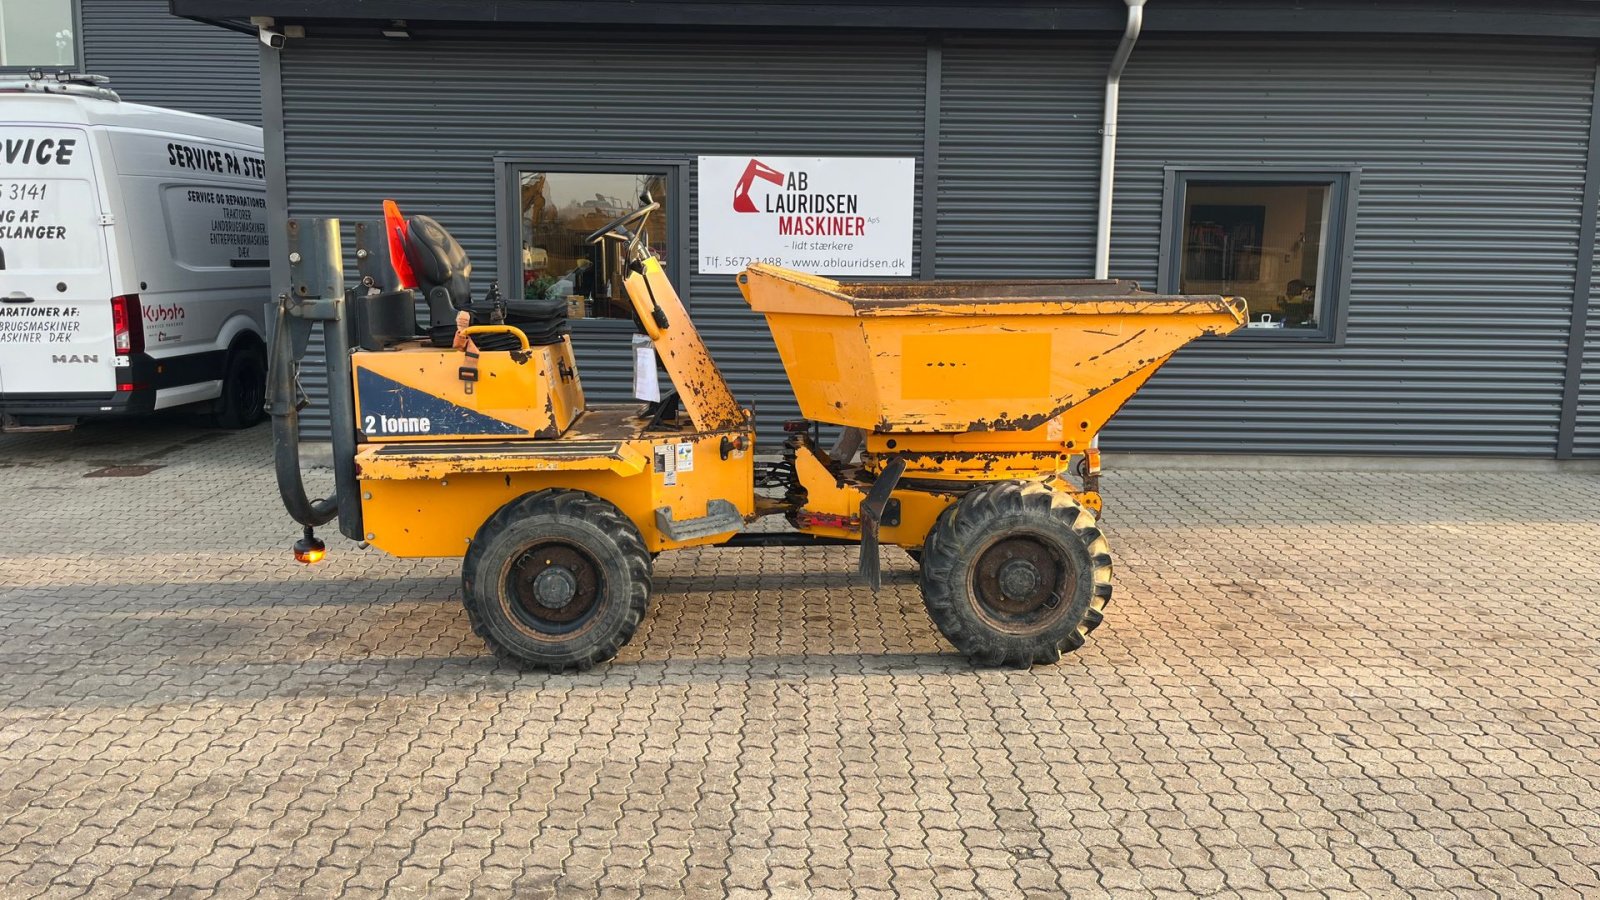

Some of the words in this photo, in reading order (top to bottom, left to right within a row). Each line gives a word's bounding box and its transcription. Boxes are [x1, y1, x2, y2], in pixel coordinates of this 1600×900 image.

[0, 138, 76, 165] VICE
[167, 142, 223, 173] SERVICE
[786, 171, 808, 191] AB
[9, 183, 47, 201] 3141
[187, 190, 215, 204] SERVICE
[215, 193, 225, 205] OG
[225, 194, 267, 209] REPARATIONER
[766, 193, 858, 214] LAURIDSEN
[20, 209, 40, 223] AF
[222, 207, 252, 221] TRAKTORER
[779, 216, 866, 236] MASKINER
[867, 216, 881, 224] ApS
[791, 240, 808, 251] lidt
[809, 240, 854, 251] stærkere
[704, 256, 722, 268] Tlf.
[725, 256, 752, 267] 5672
[792, 257, 906, 269] www.ablauridsen.dk
[62, 307, 80, 317] AF:
[142, 302, 185, 322] Kubota
[49, 332, 72, 343] DÆK
[52, 354, 98, 363] MAN
[365, 415, 377, 434] 2
[380, 414, 431, 433] tonne
